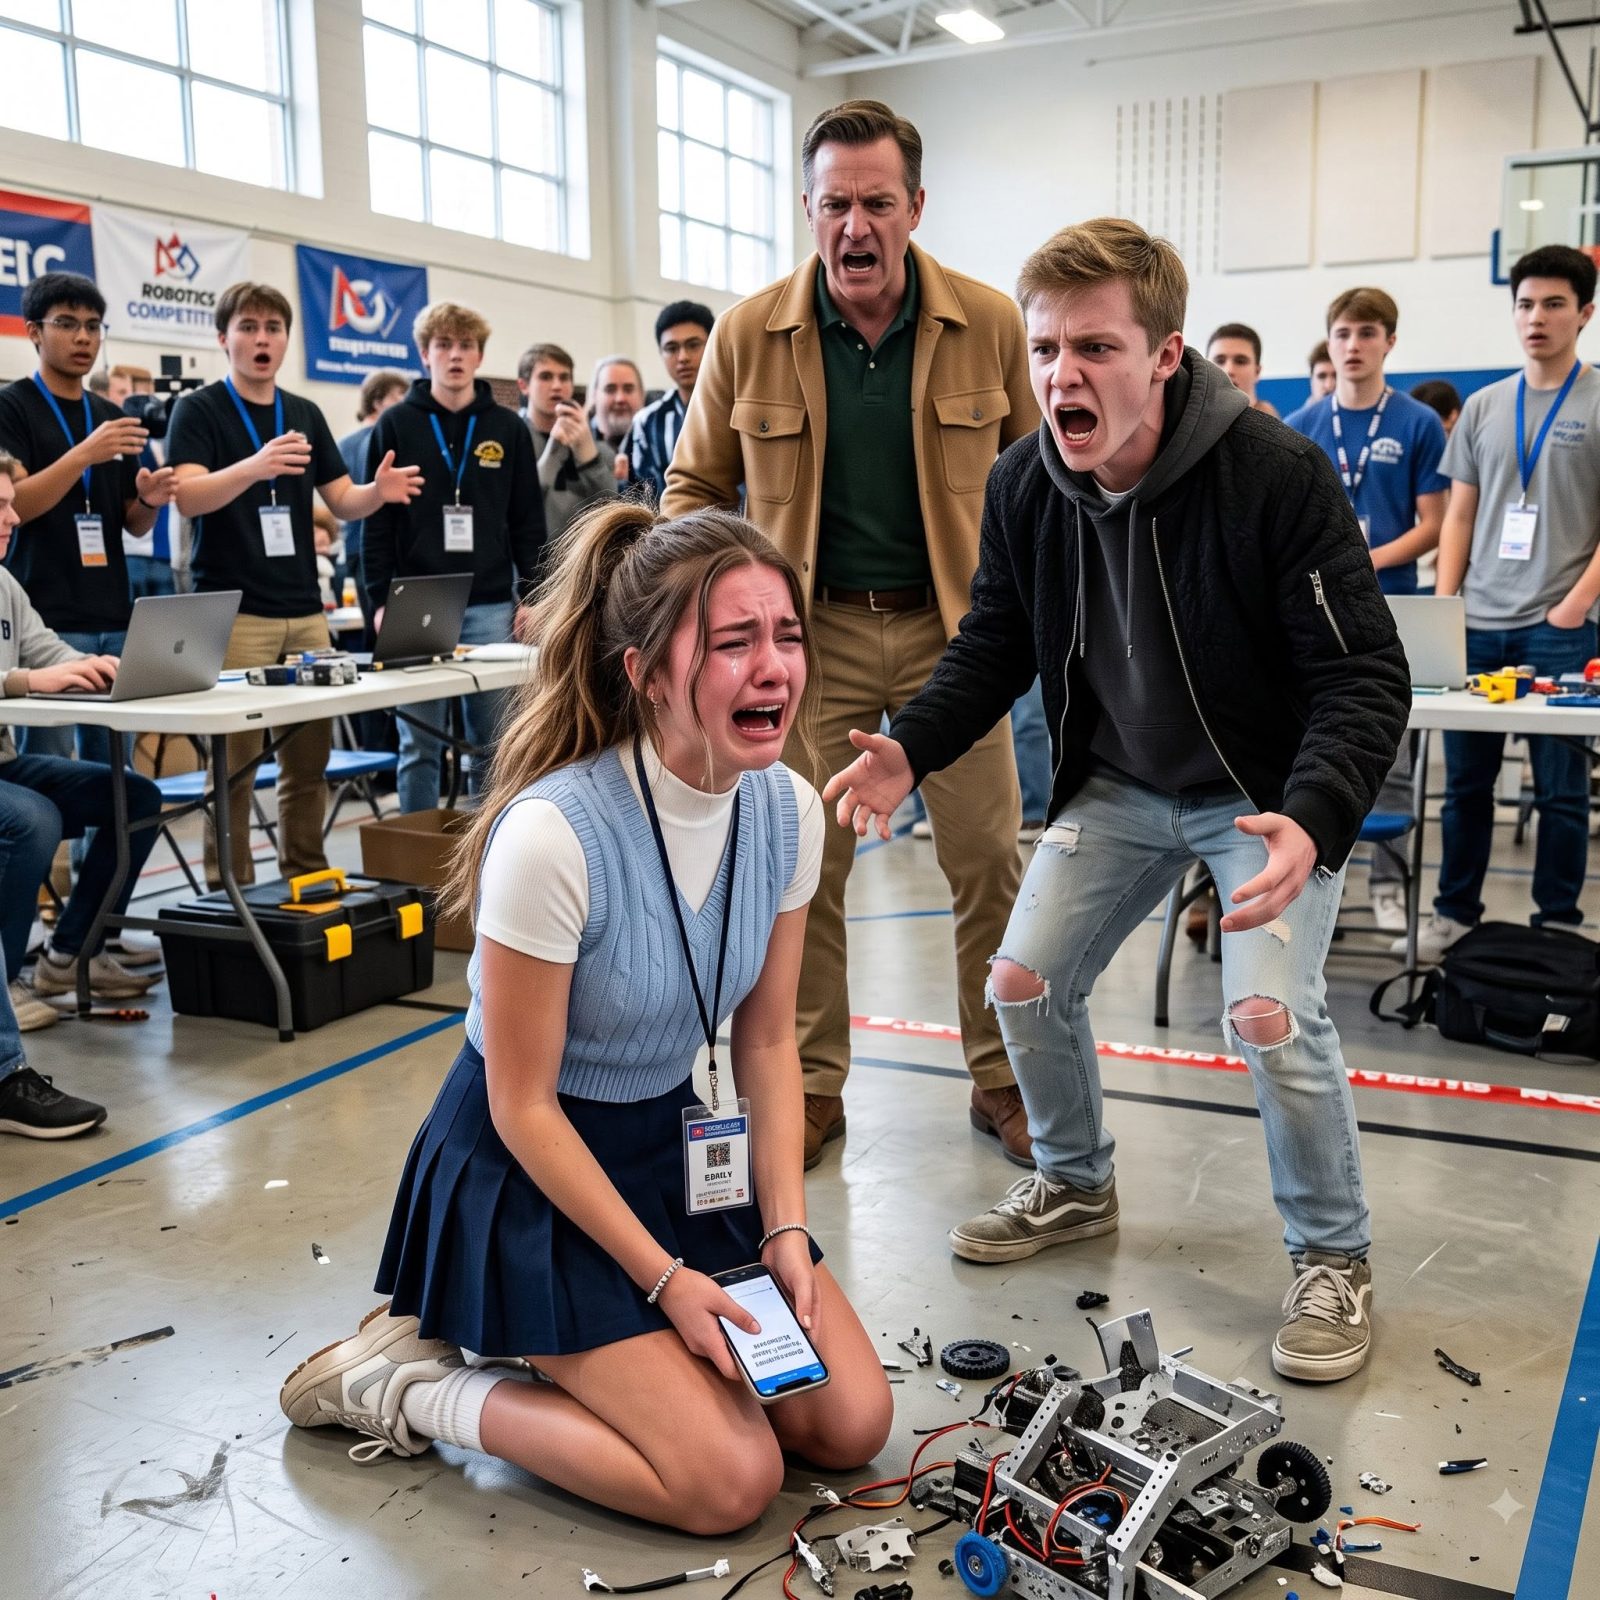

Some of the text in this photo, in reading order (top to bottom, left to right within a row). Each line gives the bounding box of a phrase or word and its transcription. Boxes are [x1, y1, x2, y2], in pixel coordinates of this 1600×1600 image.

[142, 283, 215, 307] ROBOTICS
[127, 301, 214, 326] COMPETITI
[1, 619, 11, 640] B
